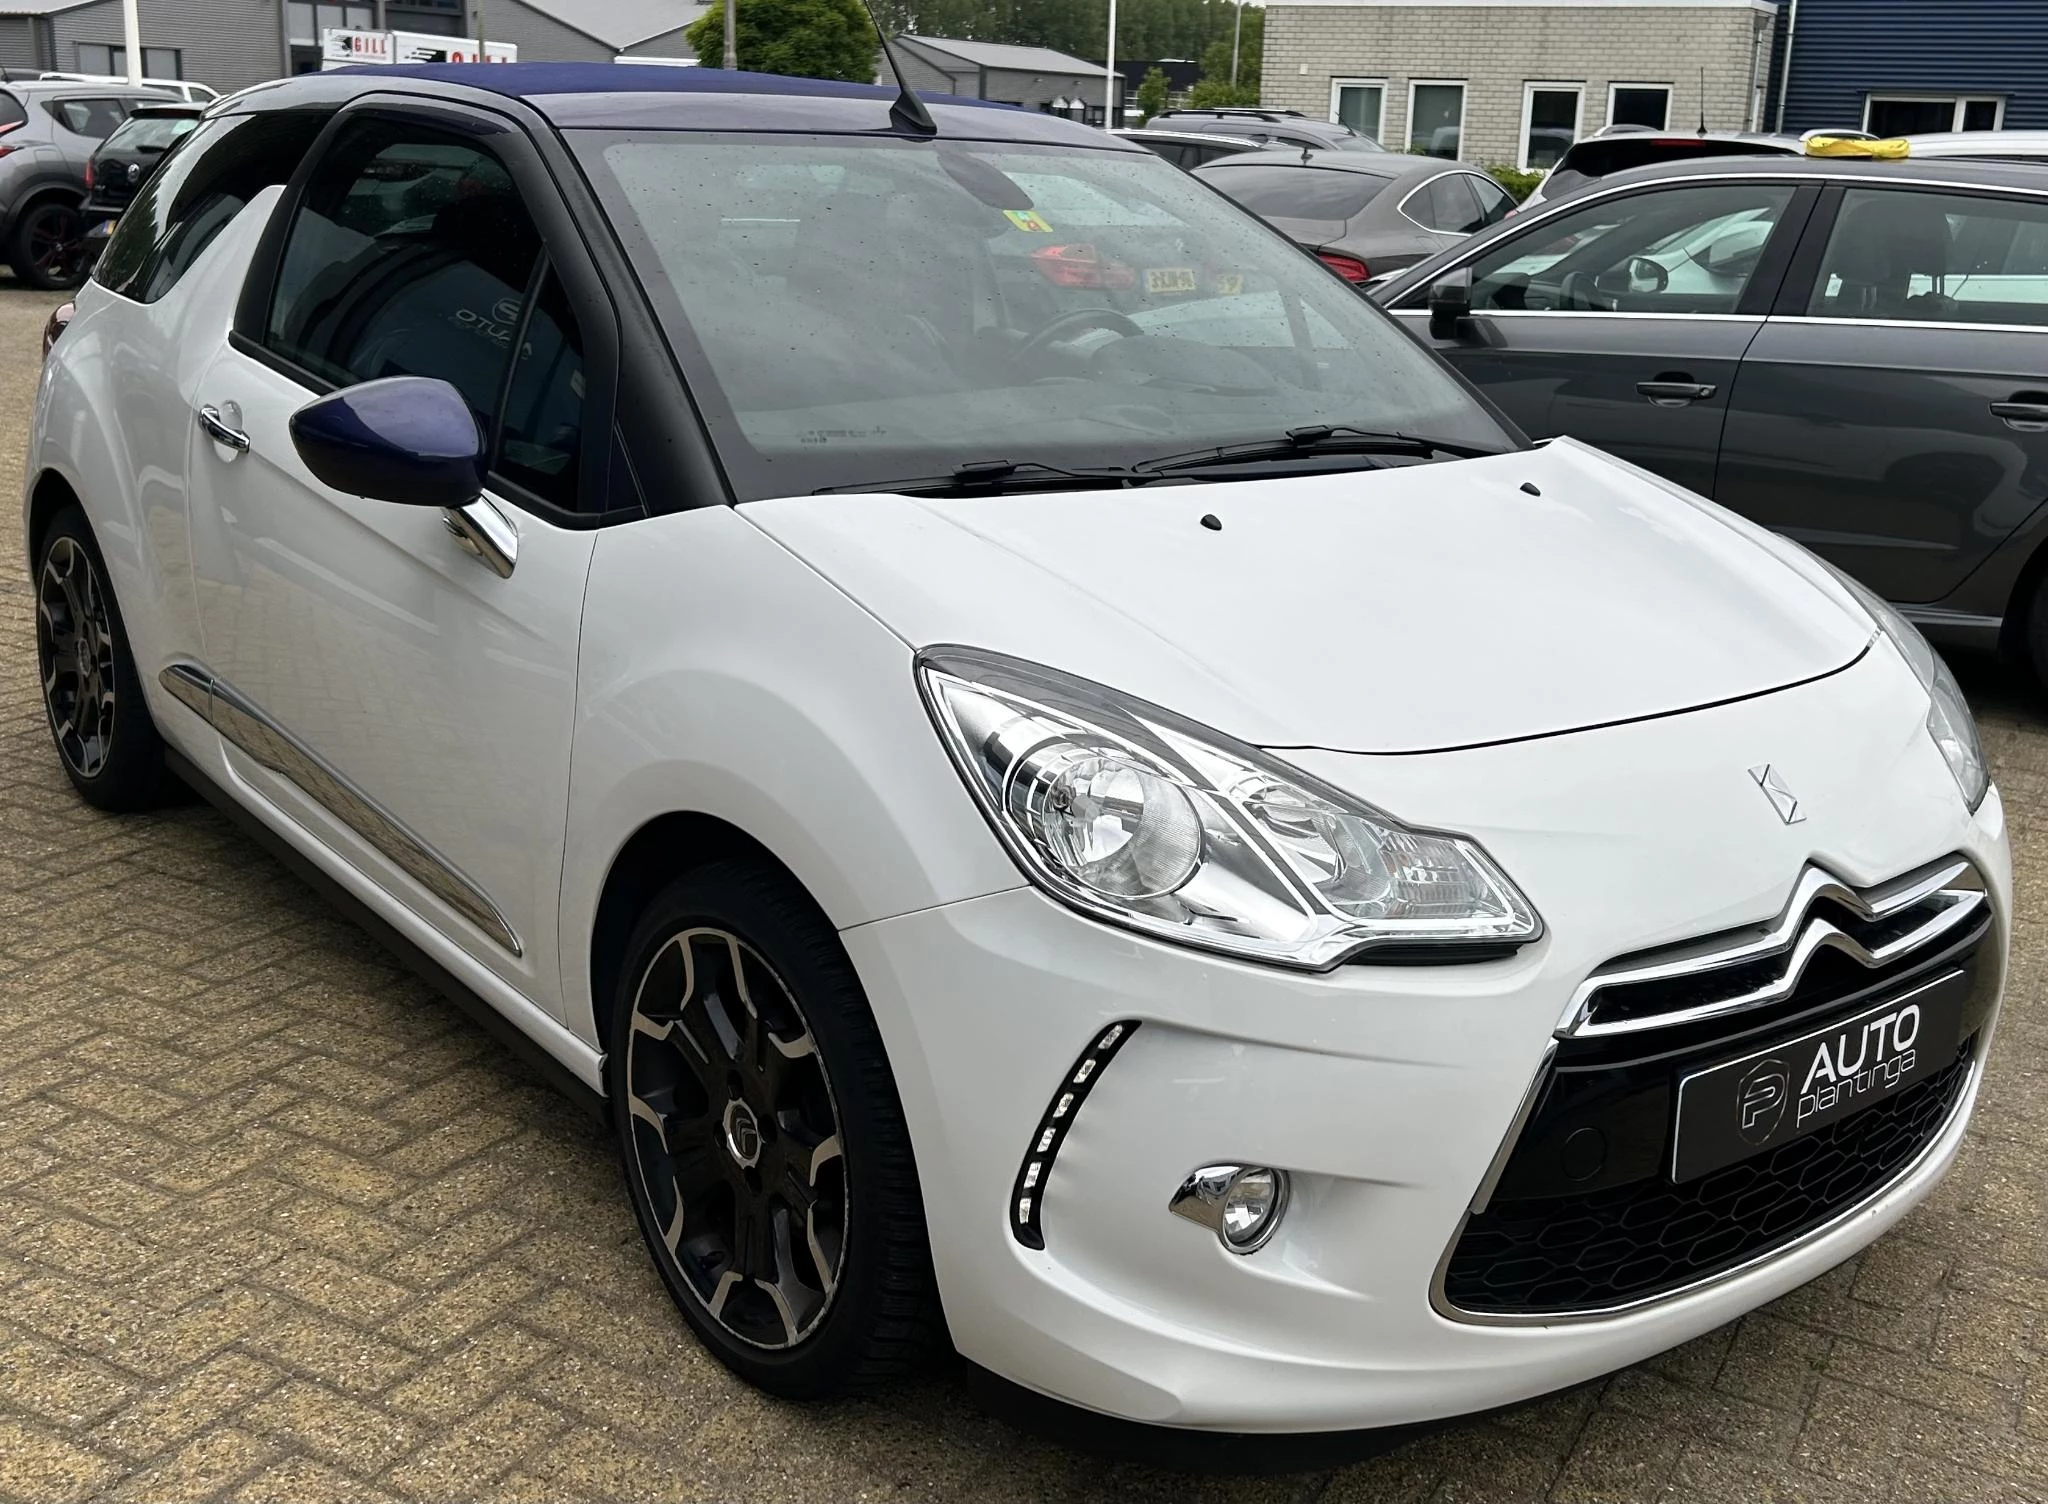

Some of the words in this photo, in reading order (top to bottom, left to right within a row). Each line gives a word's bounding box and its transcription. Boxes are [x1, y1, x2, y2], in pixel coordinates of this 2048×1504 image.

[354, 36, 387, 54] GILL
[1796, 1049, 1916, 1128] plantinga
[1800, 1004, 1920, 1095] AUTO
